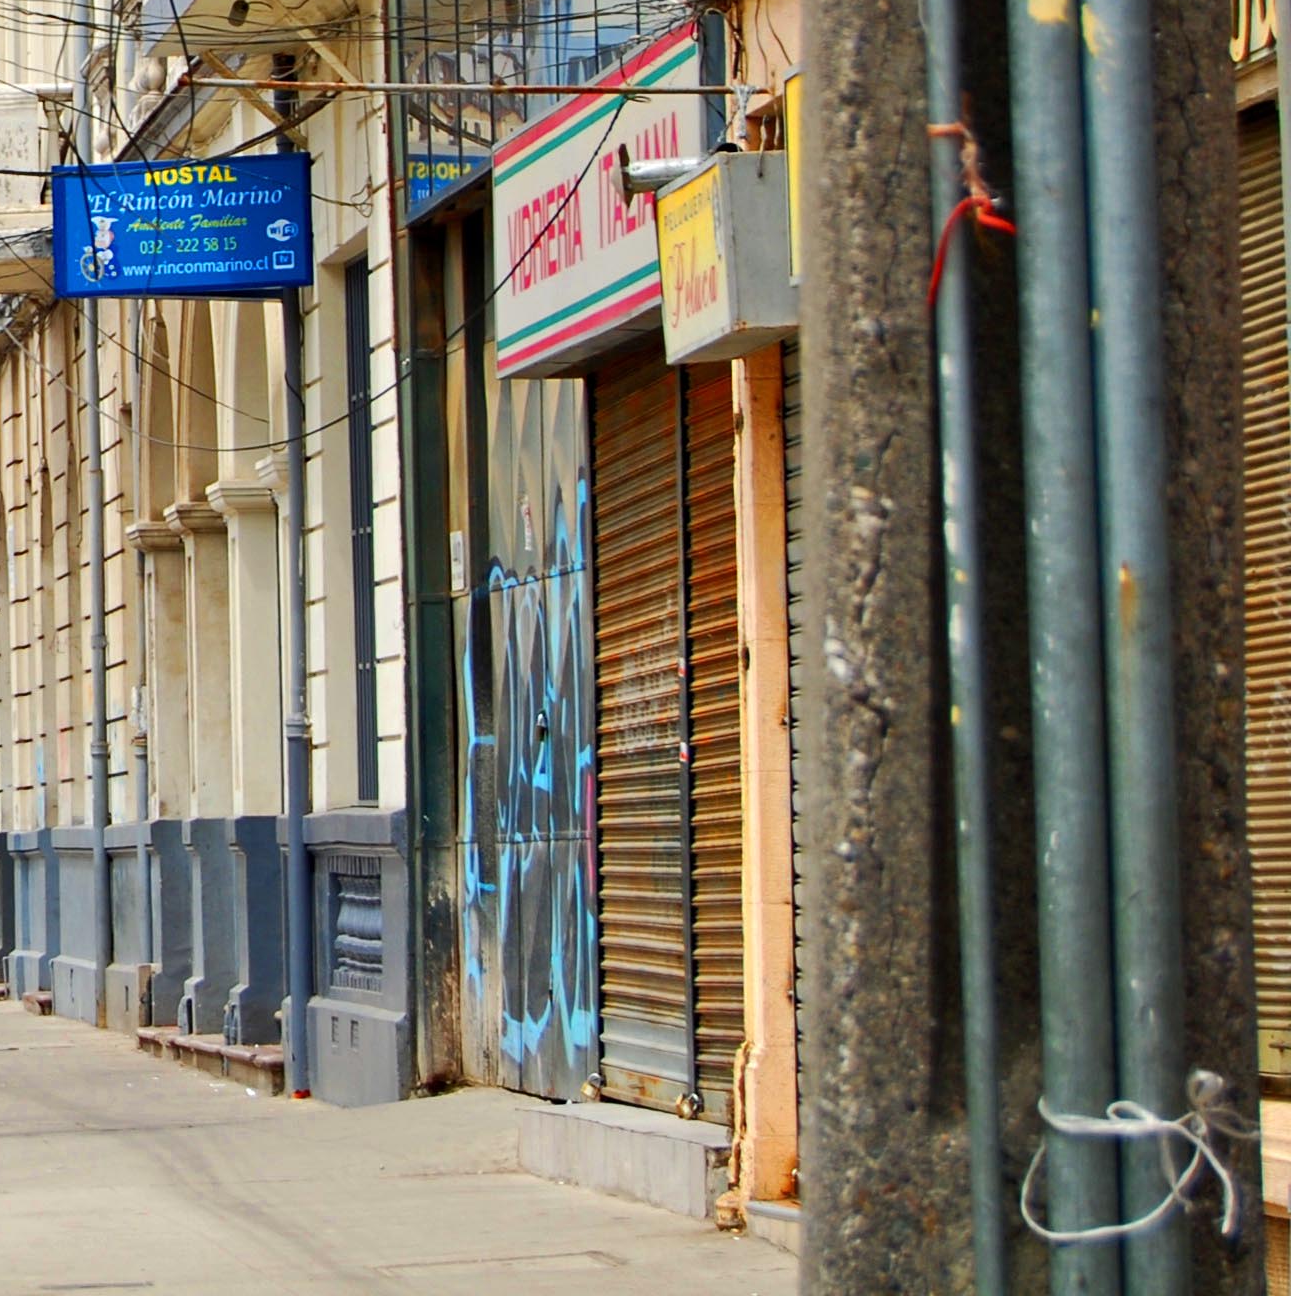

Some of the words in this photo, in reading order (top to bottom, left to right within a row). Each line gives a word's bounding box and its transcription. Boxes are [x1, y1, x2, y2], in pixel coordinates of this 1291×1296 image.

[144, 164, 238, 186] HOSTAL
[189, 213, 248, 231] Familiar
[139, 240, 163, 255] 032
[176, 237, 200, 253] 222
[203, 237, 220, 252] 58
[223, 236, 238, 251] 15
[507, 173, 584, 297] VIDRIERIA
[123, 255, 269, 276] www.rinconmarino.cl
